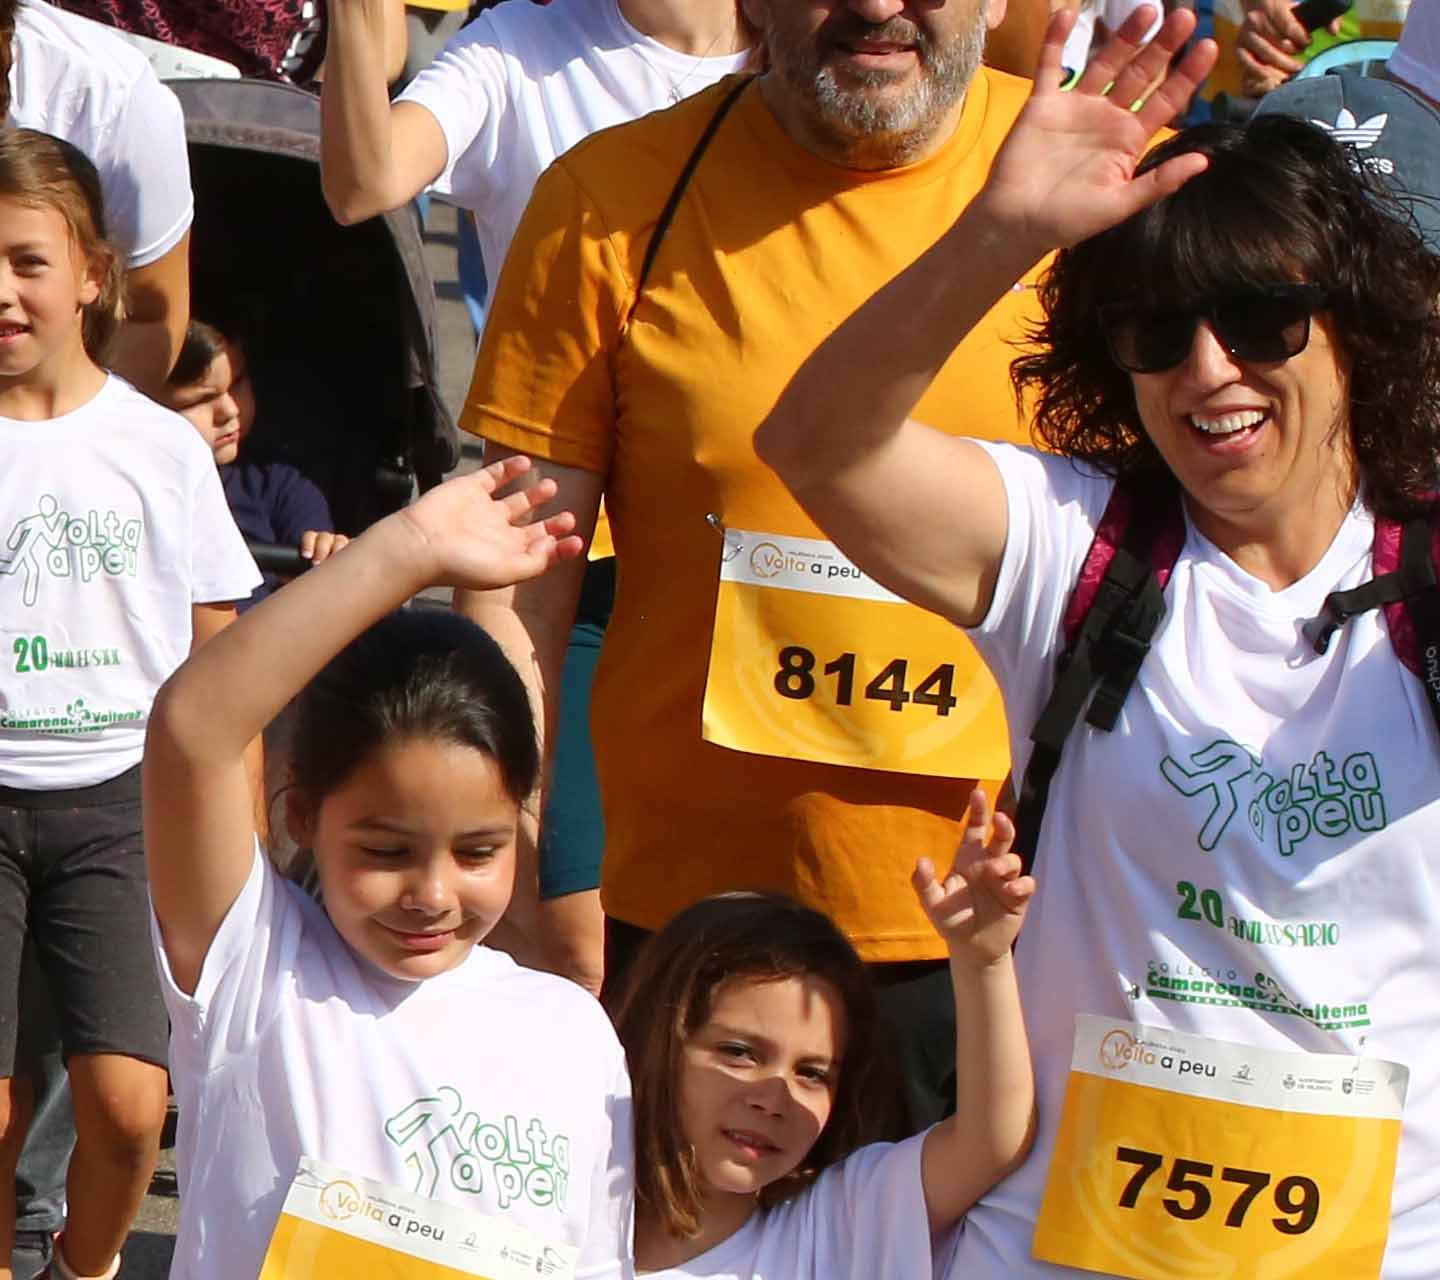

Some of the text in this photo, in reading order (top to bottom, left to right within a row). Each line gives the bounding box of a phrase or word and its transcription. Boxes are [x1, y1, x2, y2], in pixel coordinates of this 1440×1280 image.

[43, 510, 142, 548] Volta
[47, 547, 71, 577] a
[763, 553, 861, 580] Volta a peu
[13, 635, 48, 674] 20
[772, 645, 957, 717] 8144
[1278, 792, 1387, 856] peu
[1176, 879, 1225, 929] 20
[1291, 996, 1369, 1021] alterna
[1113, 1039, 1157, 1066] Volta
[1160, 1053, 1174, 1070] a
[1177, 1056, 1218, 1078] peu
[450, 1153, 483, 1194] a
[1114, 1146, 1322, 1235] 7579
[336, 1190, 446, 1242] Volta a peu
